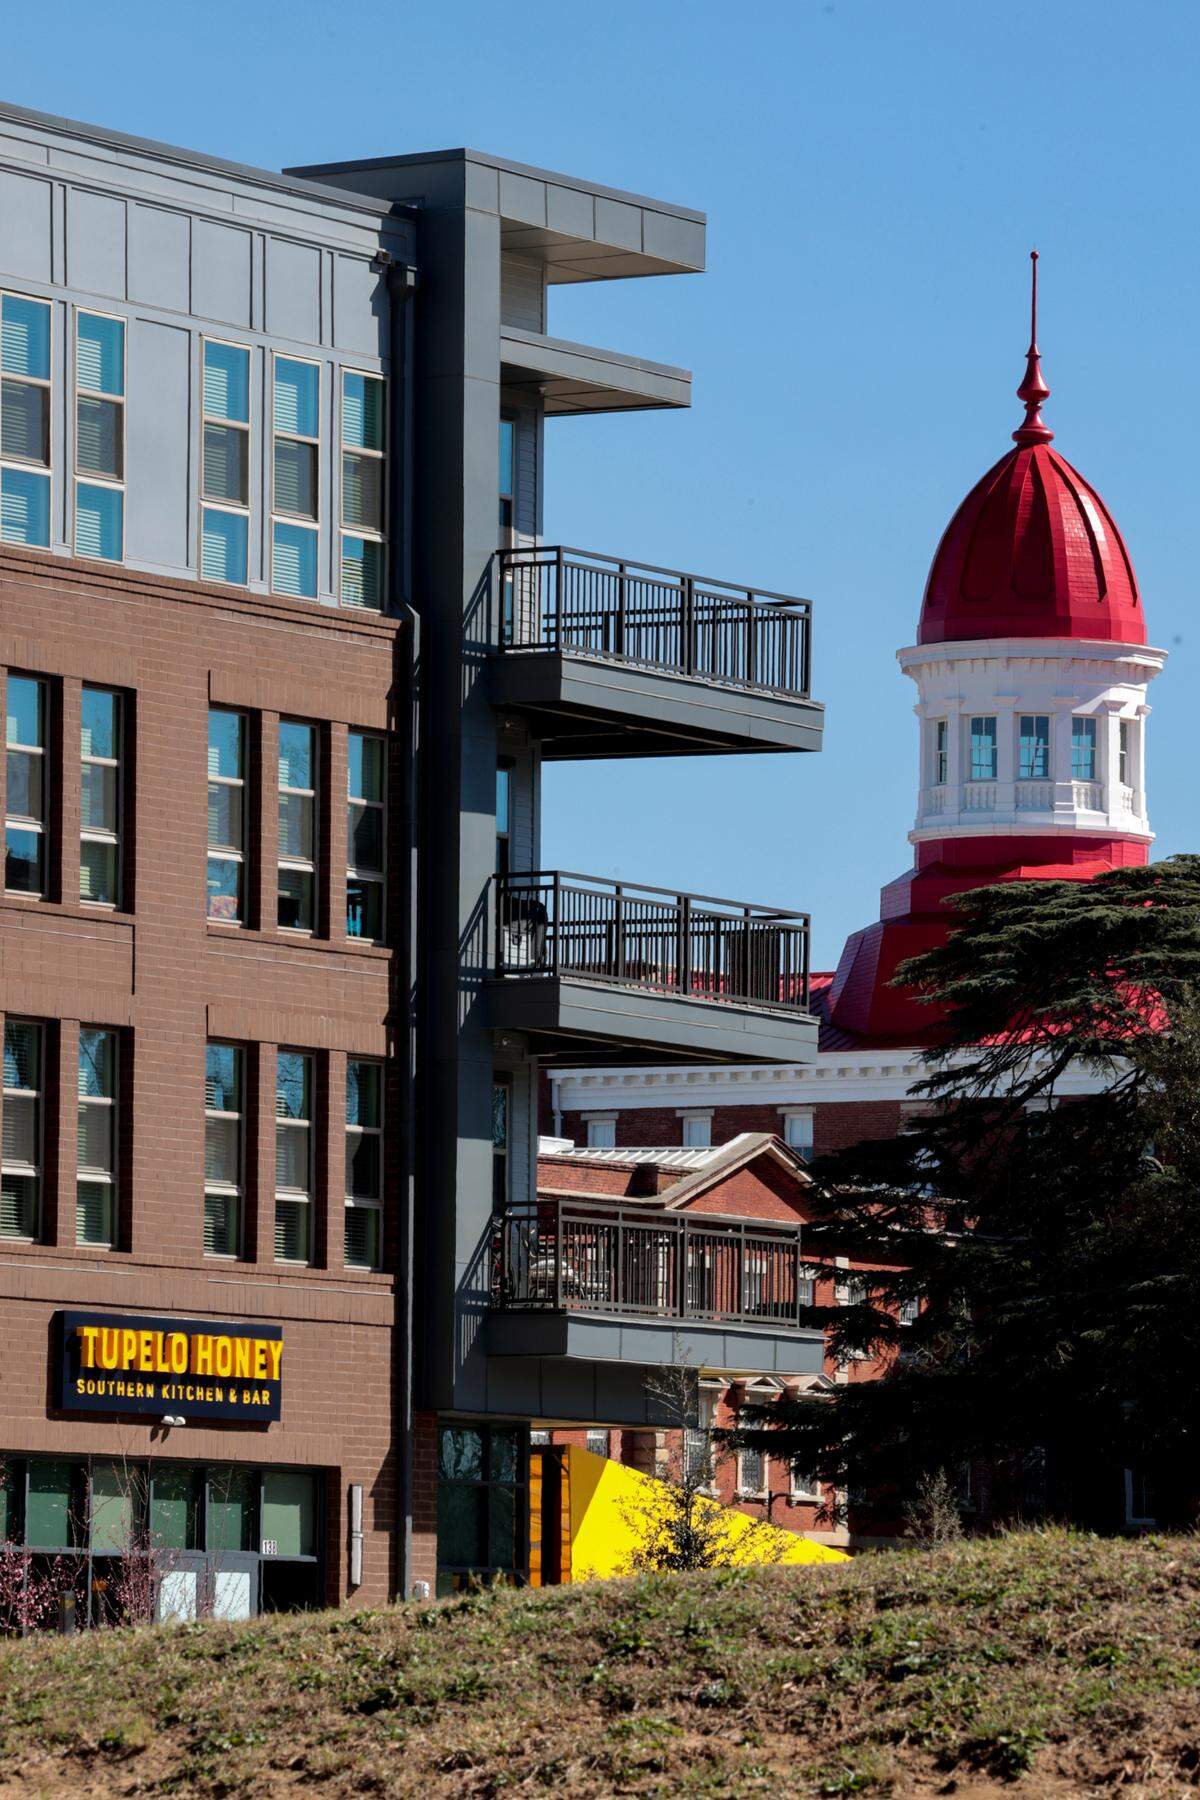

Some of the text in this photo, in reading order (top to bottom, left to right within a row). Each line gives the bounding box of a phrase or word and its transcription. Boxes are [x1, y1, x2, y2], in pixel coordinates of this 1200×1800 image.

[78, 1326, 284, 1380] TUPELO HONEY
[77, 1379, 270, 1405] SOUTHERN KITCHEN & BAR
